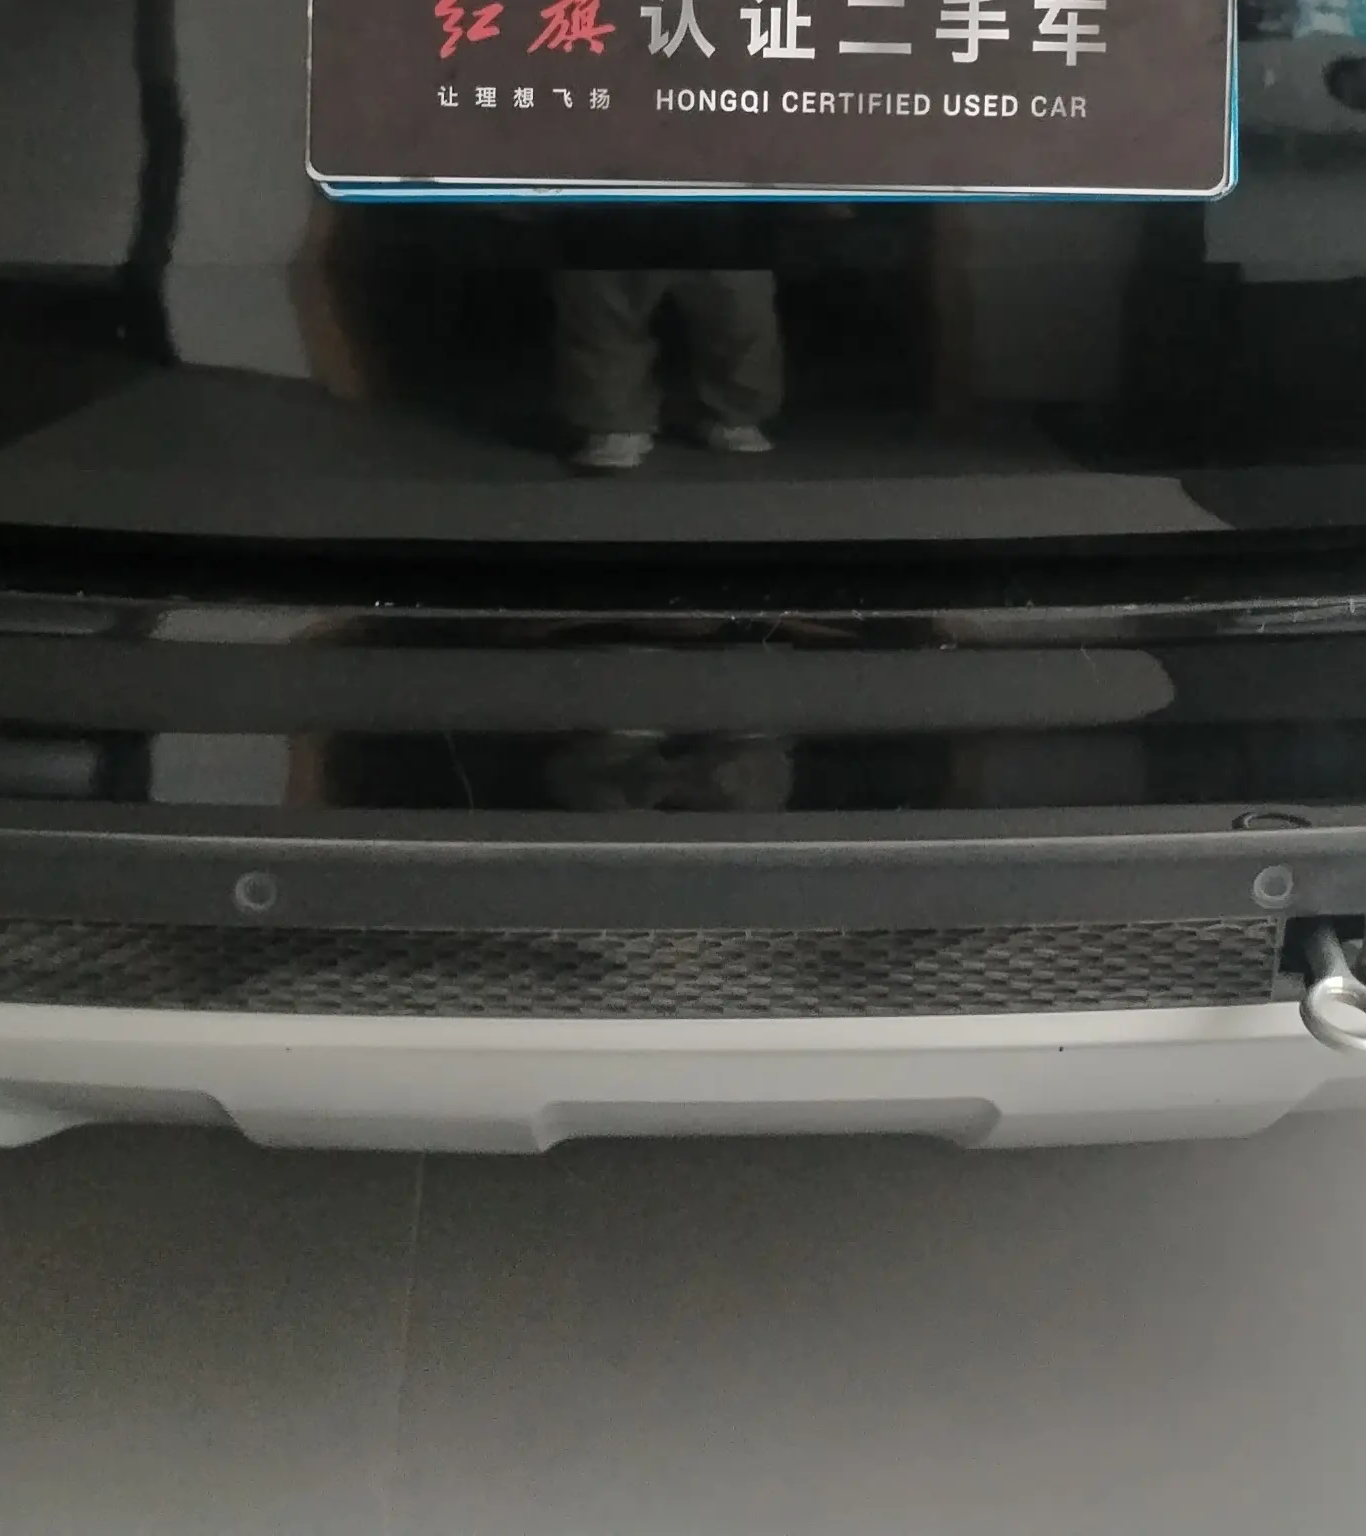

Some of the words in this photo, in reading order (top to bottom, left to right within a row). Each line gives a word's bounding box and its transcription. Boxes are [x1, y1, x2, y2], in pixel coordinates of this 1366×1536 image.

[437, 85, 612, 110] 让理想飞扬
[655, 88, 770, 114] HONGQI
[781, 90, 931, 116] CERTIFIED
[942, 93, 1018, 118] USED
[1030, 95, 1088, 119] CAR
